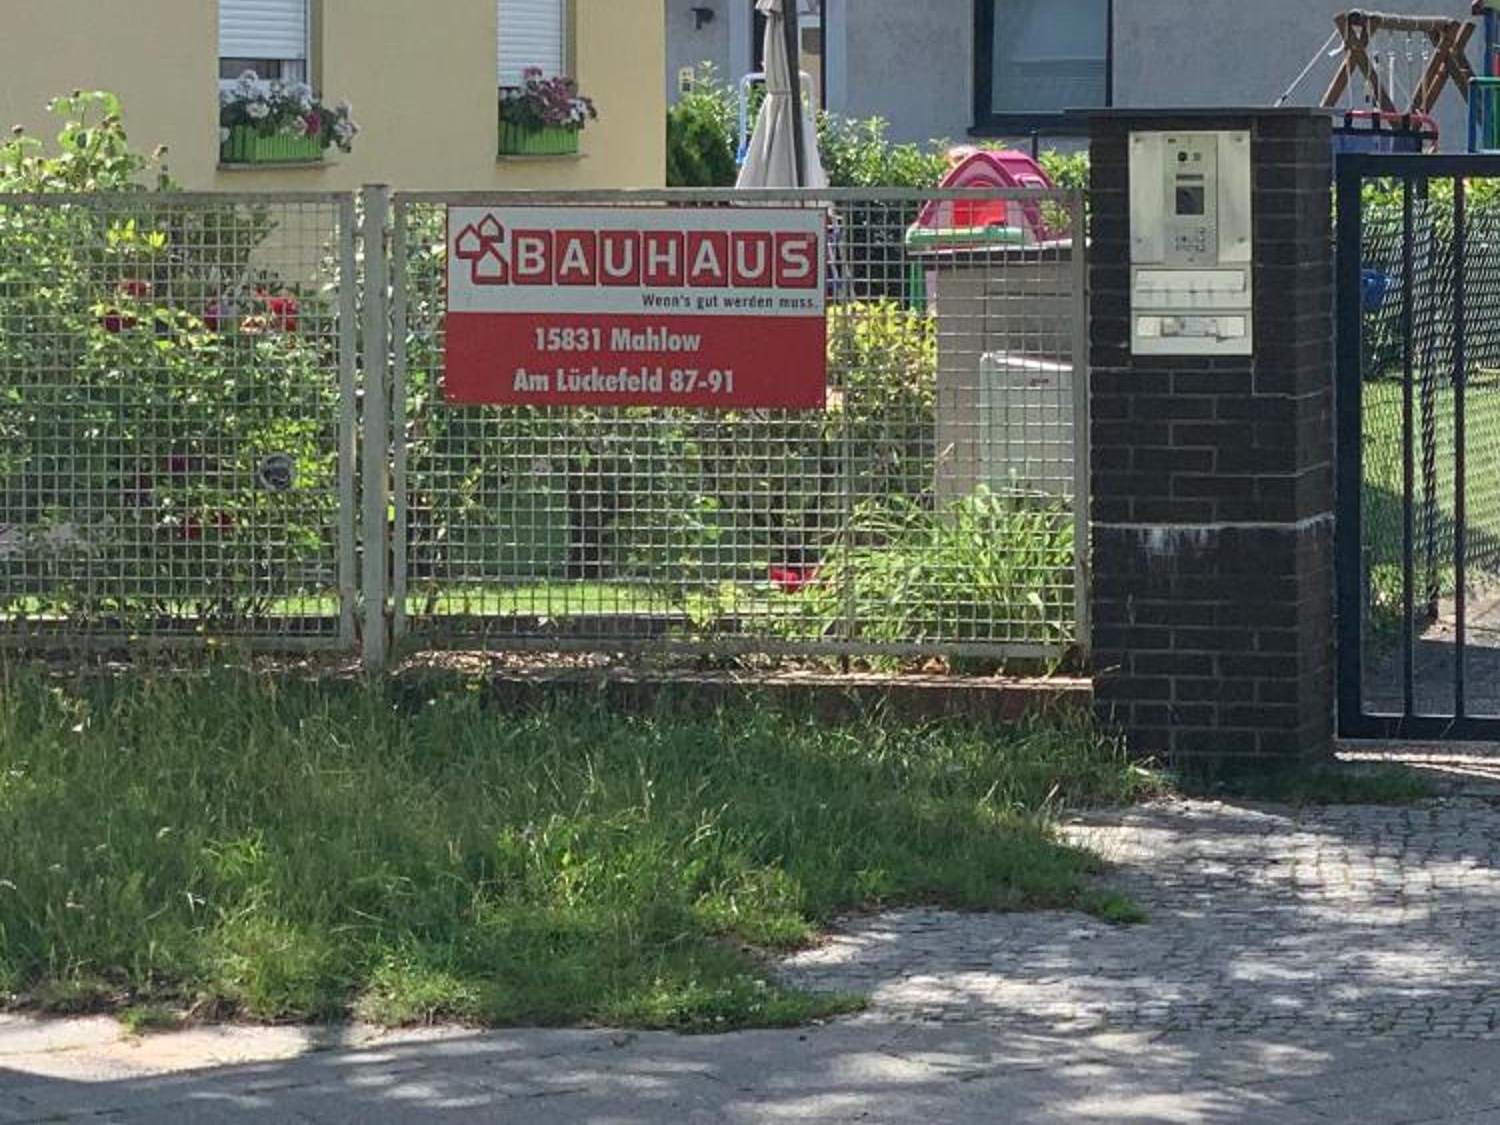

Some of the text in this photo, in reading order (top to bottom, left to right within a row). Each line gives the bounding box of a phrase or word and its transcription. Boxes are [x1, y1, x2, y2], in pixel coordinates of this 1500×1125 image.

[515, 236, 813, 279] BAUHAUS
[641, 293, 819, 310] Wenn's gut werden muss.
[535, 327, 701, 353] 15831 Mahlow
[513, 368, 735, 394] Am Lückefeld 87-91
